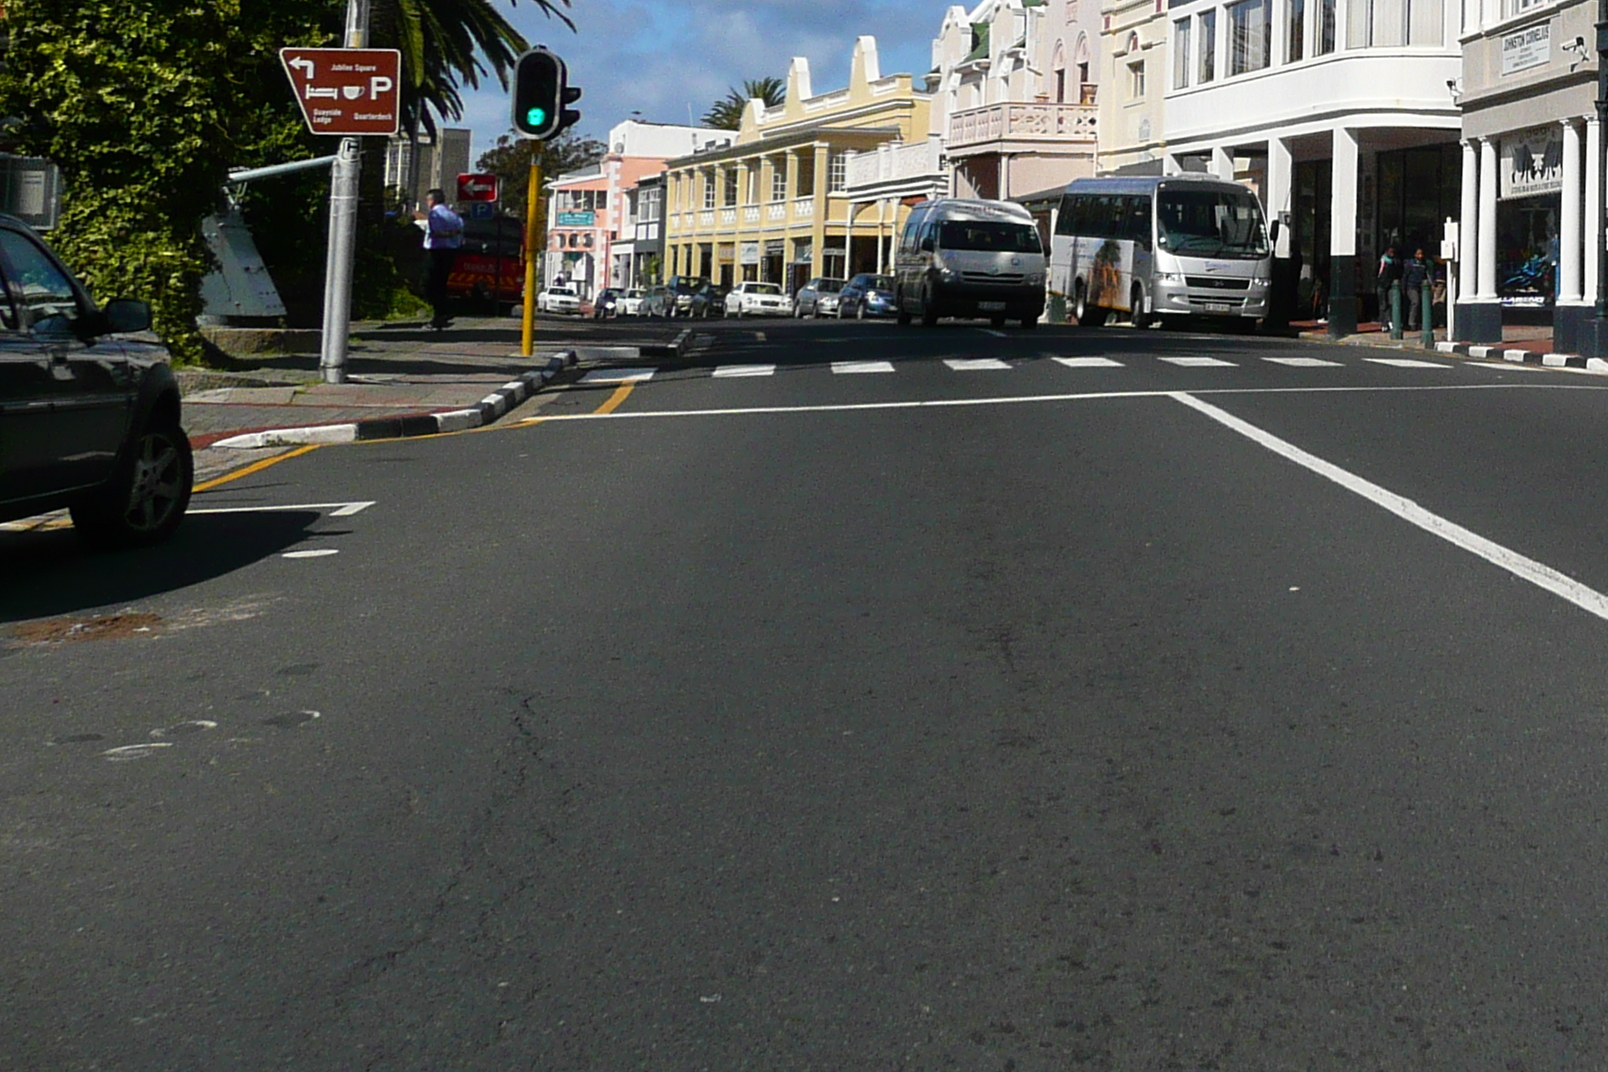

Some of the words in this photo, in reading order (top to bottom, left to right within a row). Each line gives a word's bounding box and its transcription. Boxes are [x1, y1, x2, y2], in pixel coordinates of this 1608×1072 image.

[331, 63, 353, 71] Jubilee
[355, 63, 376, 73] Square
[312, 116, 332, 125] Lodge
